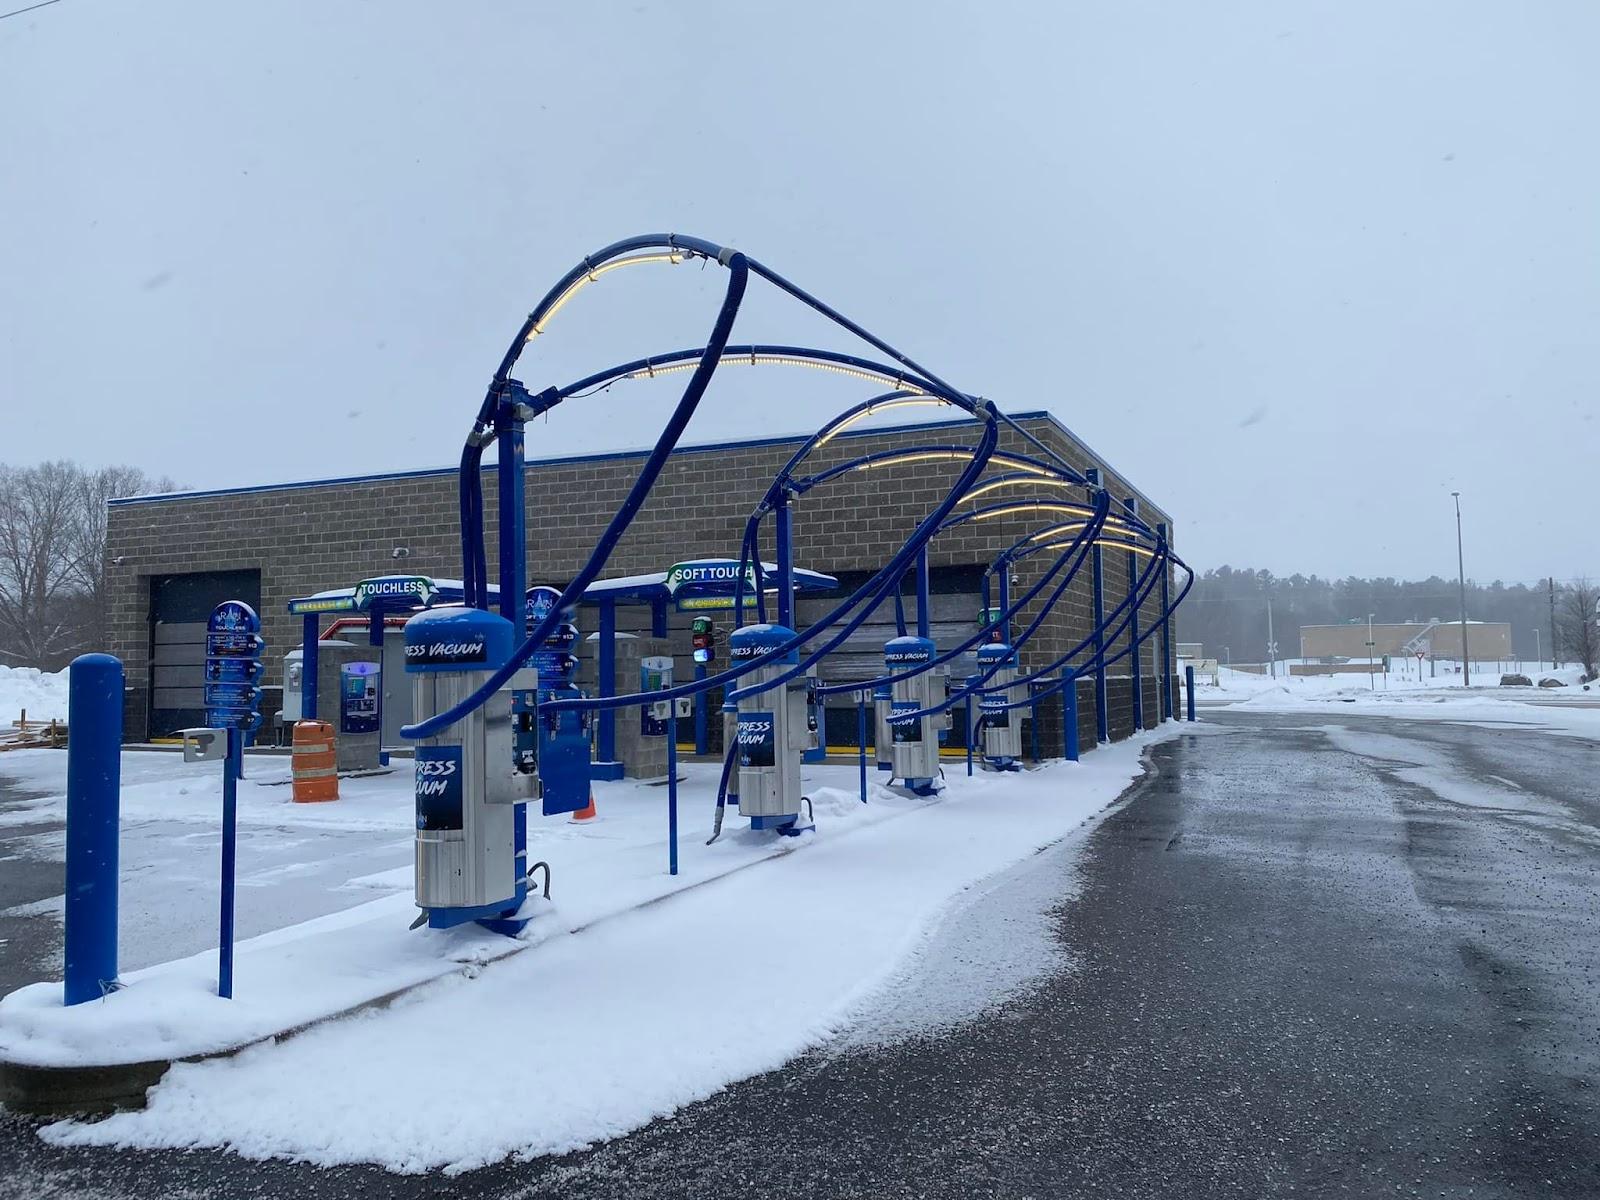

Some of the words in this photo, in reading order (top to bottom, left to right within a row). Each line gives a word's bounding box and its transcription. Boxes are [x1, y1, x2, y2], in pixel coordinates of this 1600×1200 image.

[674, 568, 707, 580] SOFT
[361, 581, 423, 595] TOUCHLESS
[429, 642, 483, 656] VACUUM
[738, 721, 771, 732] PRESS
[415, 779, 448, 796] UUM
